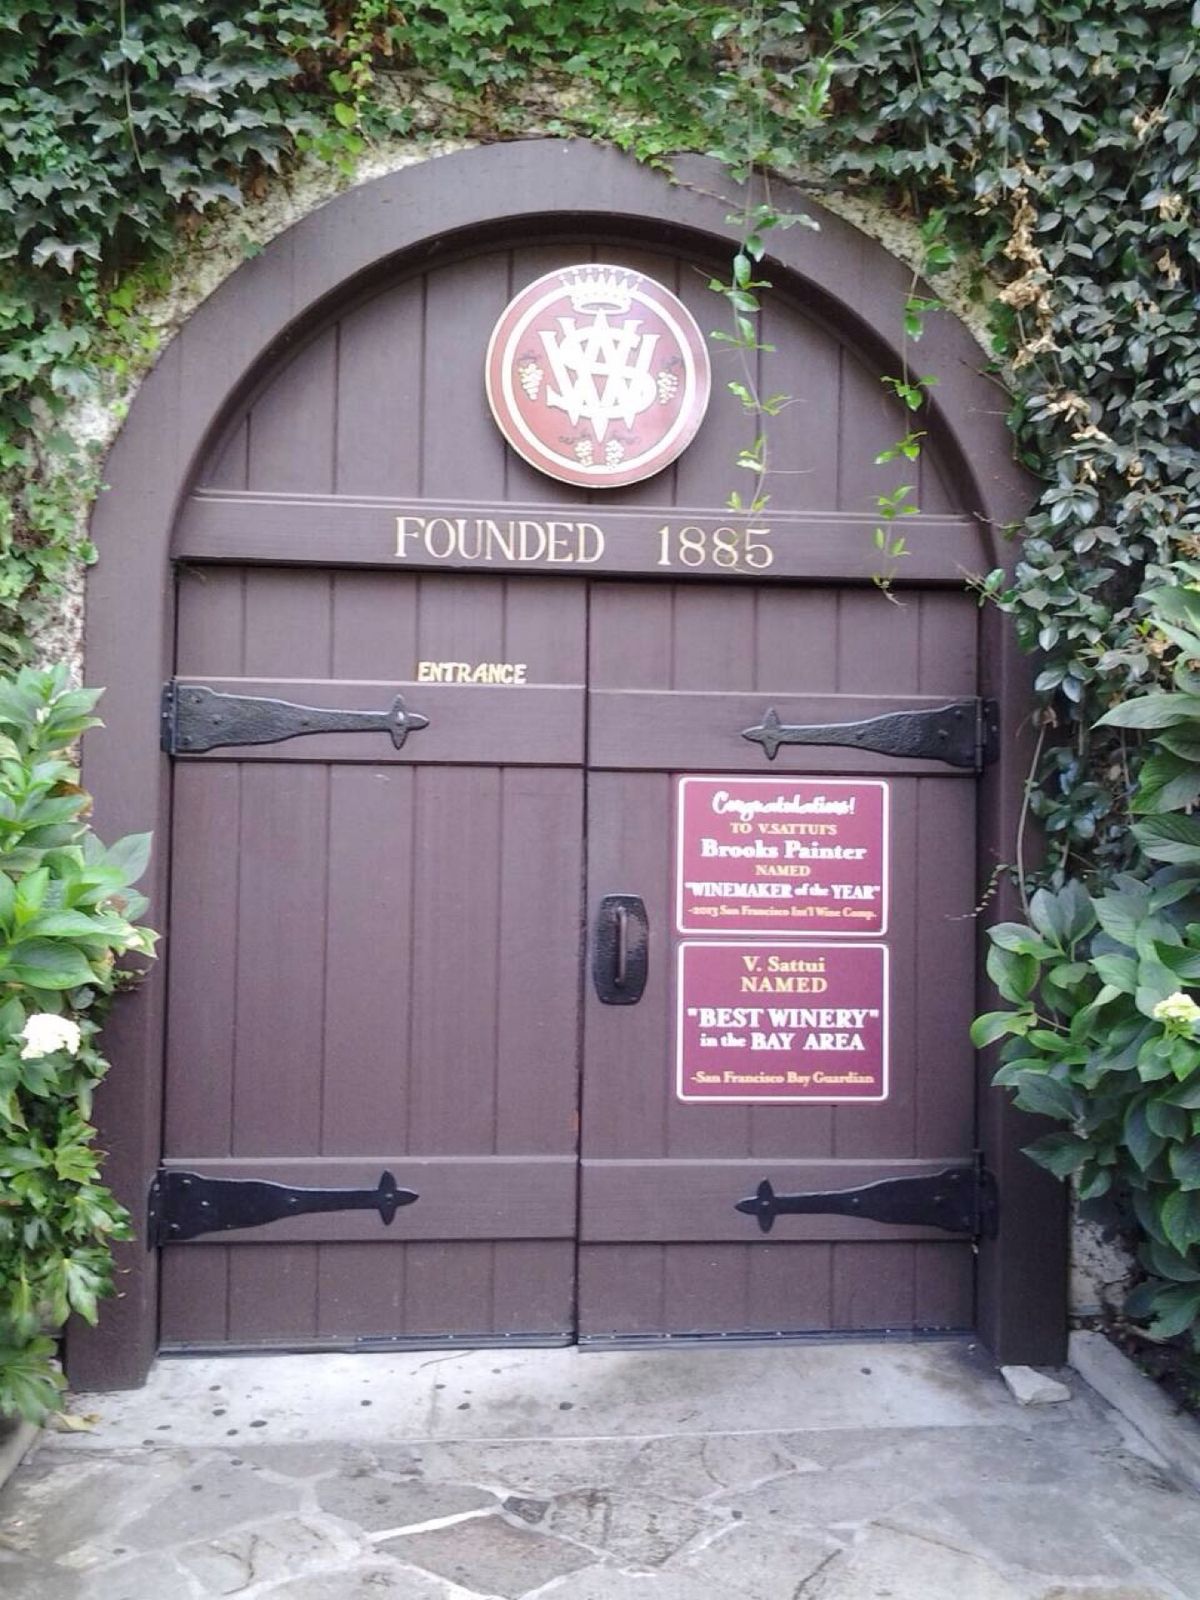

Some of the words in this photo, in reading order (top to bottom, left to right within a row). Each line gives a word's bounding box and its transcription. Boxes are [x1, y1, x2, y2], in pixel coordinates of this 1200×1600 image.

[394, 516, 606, 563] FOUNDED
[656, 525, 774, 568] 1885
[417, 661, 528, 684] ENTRANCE
[711, 790, 857, 821] Congratulations!
[730, 822, 753, 834] TO
[700, 838, 780, 859] Brooks
[783, 839, 868, 860] Painter
[754, 865, 812, 877] NAMED
[794, 882, 809, 896] of
[809, 882, 830, 896] the
[719, 904, 740, 916] San
[741, 904, 790, 916] Francisco
[815, 906, 841, 918] Wine
[742, 955, 763, 972] V.
[768, 955, 826, 973] Sattui
[740, 976, 829, 994] NAMED
[687, 1007, 765, 1029] "BEST
[766, 1008, 880, 1029] WINERY"
[700, 1033, 719, 1048] in
[720, 1032, 747, 1048] the
[750, 1032, 796, 1051] BAY
[802, 1033, 866, 1051] AREA
[723, 1071, 786, 1085] Francisco
[786, 1071, 811, 1087] Bay
[812, 1071, 875, 1085] Guardian
